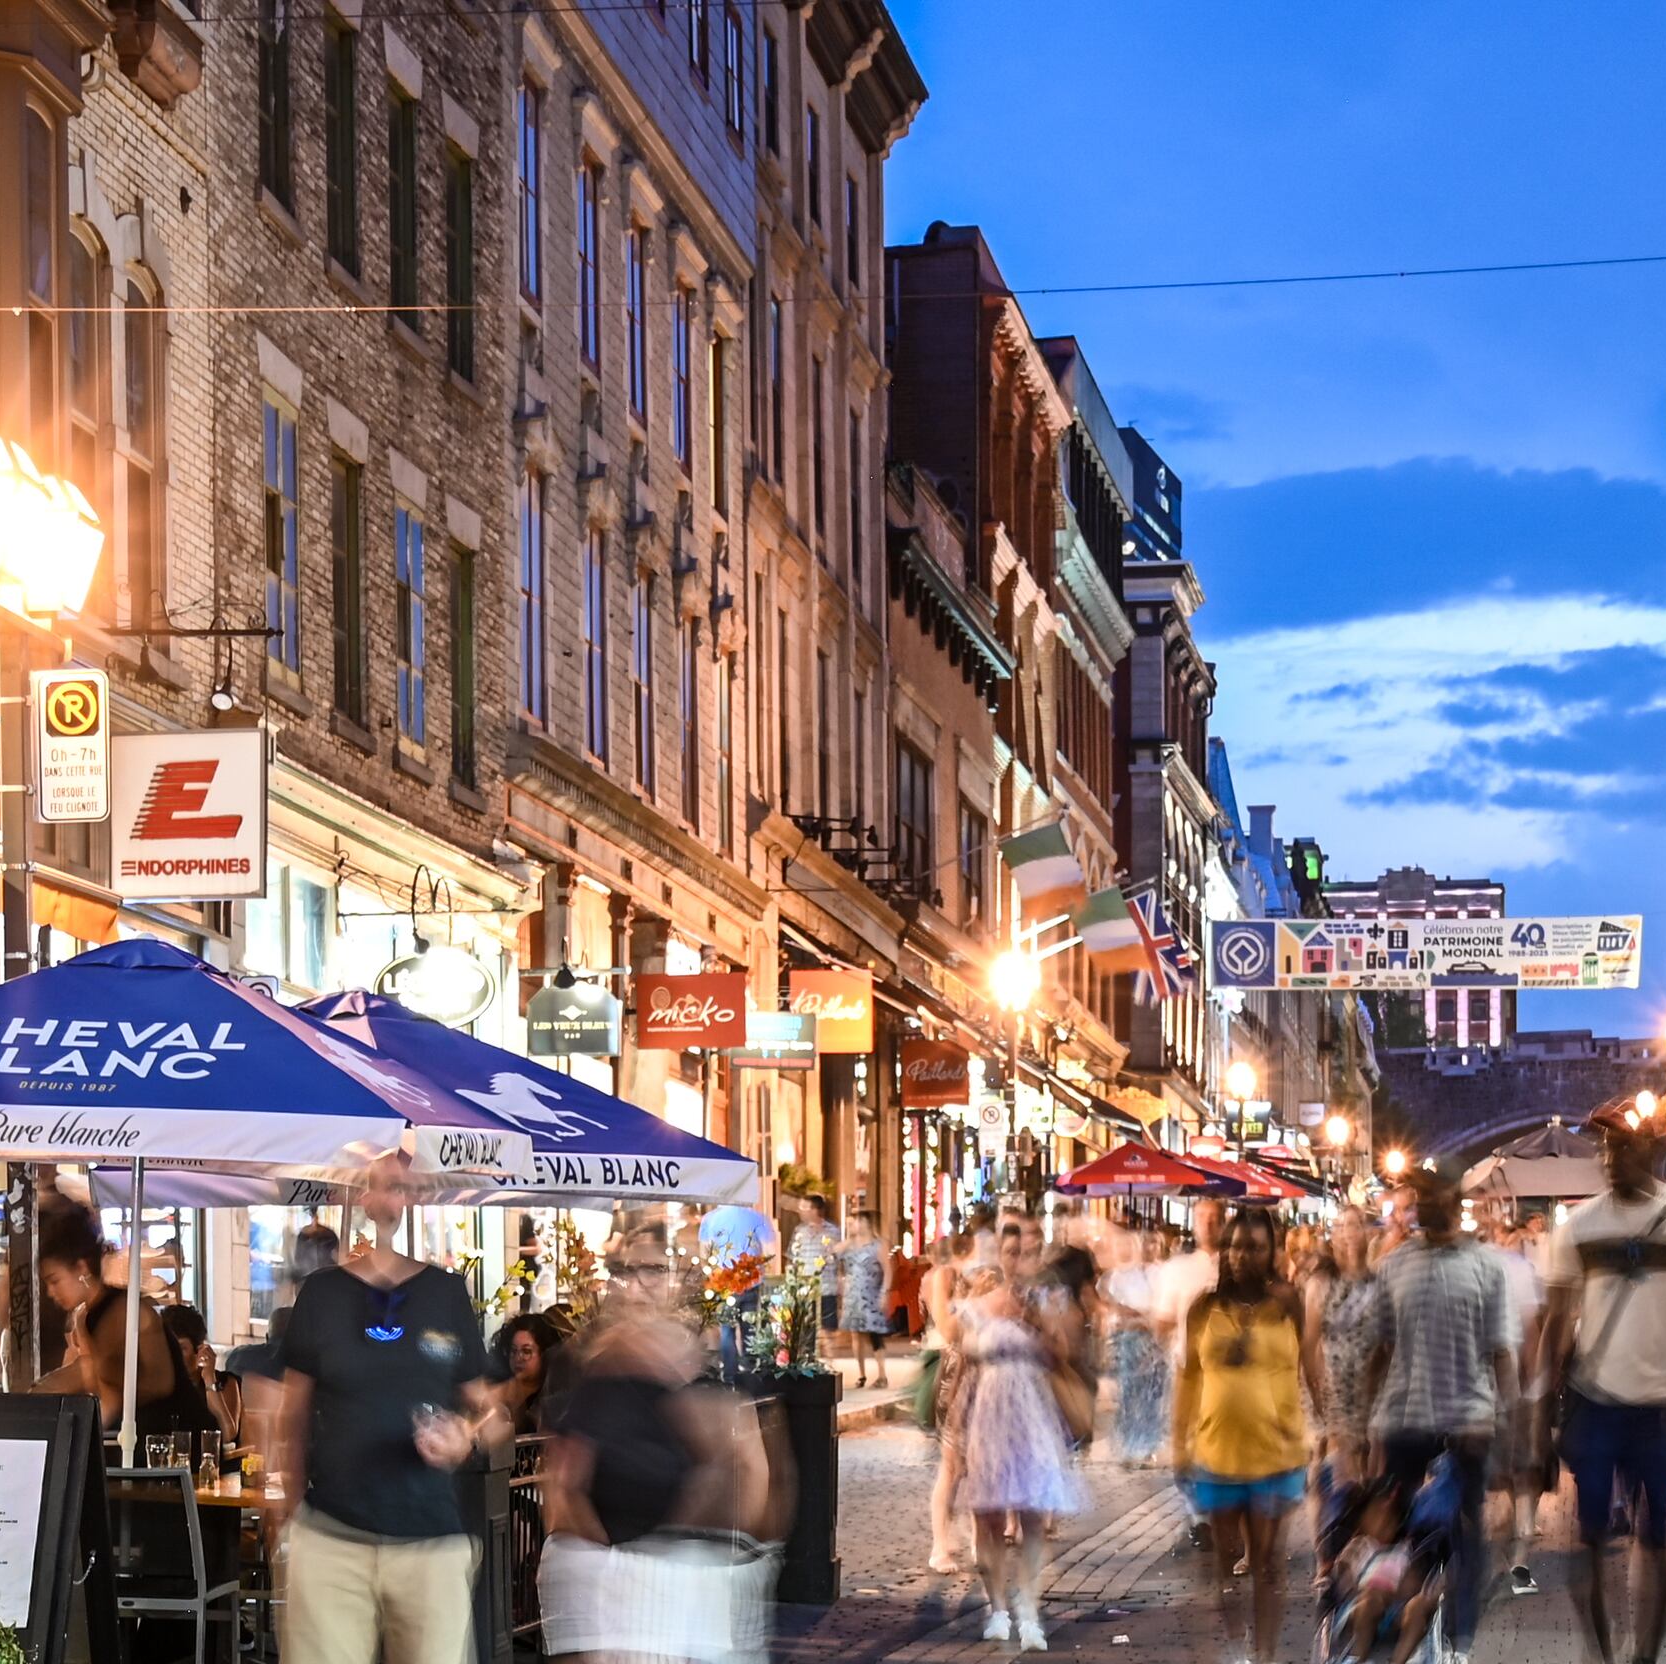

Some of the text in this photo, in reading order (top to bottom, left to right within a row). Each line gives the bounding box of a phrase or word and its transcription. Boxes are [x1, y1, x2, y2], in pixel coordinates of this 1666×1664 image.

[87, 787, 95, 798] LE
[121, 859, 251, 876] ENDORPHINES
[1424, 936, 1504, 946] PATRIMOINE
[1510, 923, 1545, 948] 40
[1442, 948, 1504, 958] MONDIAL
[19, 1081, 117, 1092] DEPUIS 1987
[48, 1111, 141, 1148] blanche
[496, 1157, 681, 1188] EVAL BLANC
